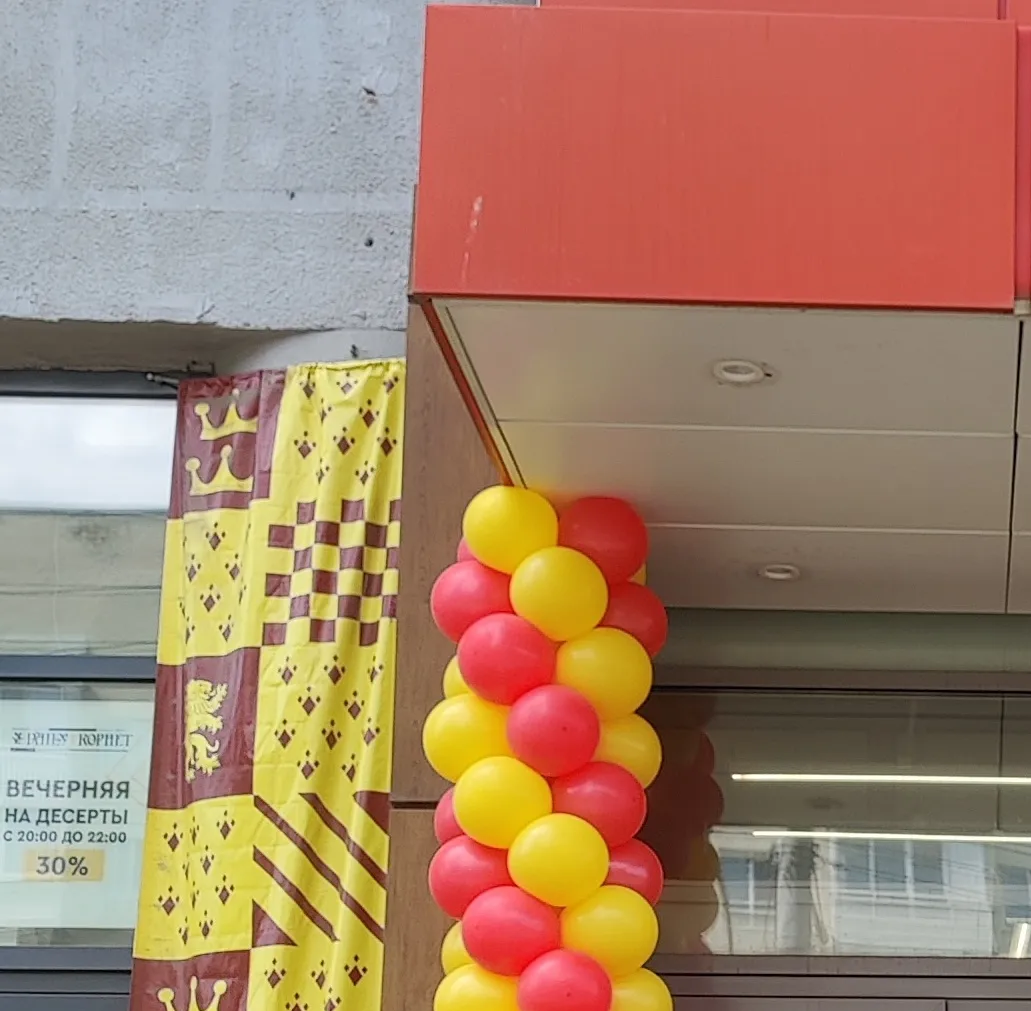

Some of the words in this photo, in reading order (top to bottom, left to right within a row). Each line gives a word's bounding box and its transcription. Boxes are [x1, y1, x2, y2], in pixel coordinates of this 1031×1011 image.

[6, 779, 130, 799] ВЕЧЕРНЯЯ
[4, 808, 31, 824] НА
[36, 808, 129, 826] ДЕСЕРТЫ
[3, 831, 13, 842] С
[17, 831, 57, 843] 20:00
[61, 831, 83, 844] ДО
[87, 831, 127, 843] 22:00
[36, 856, 89, 876] 30%
